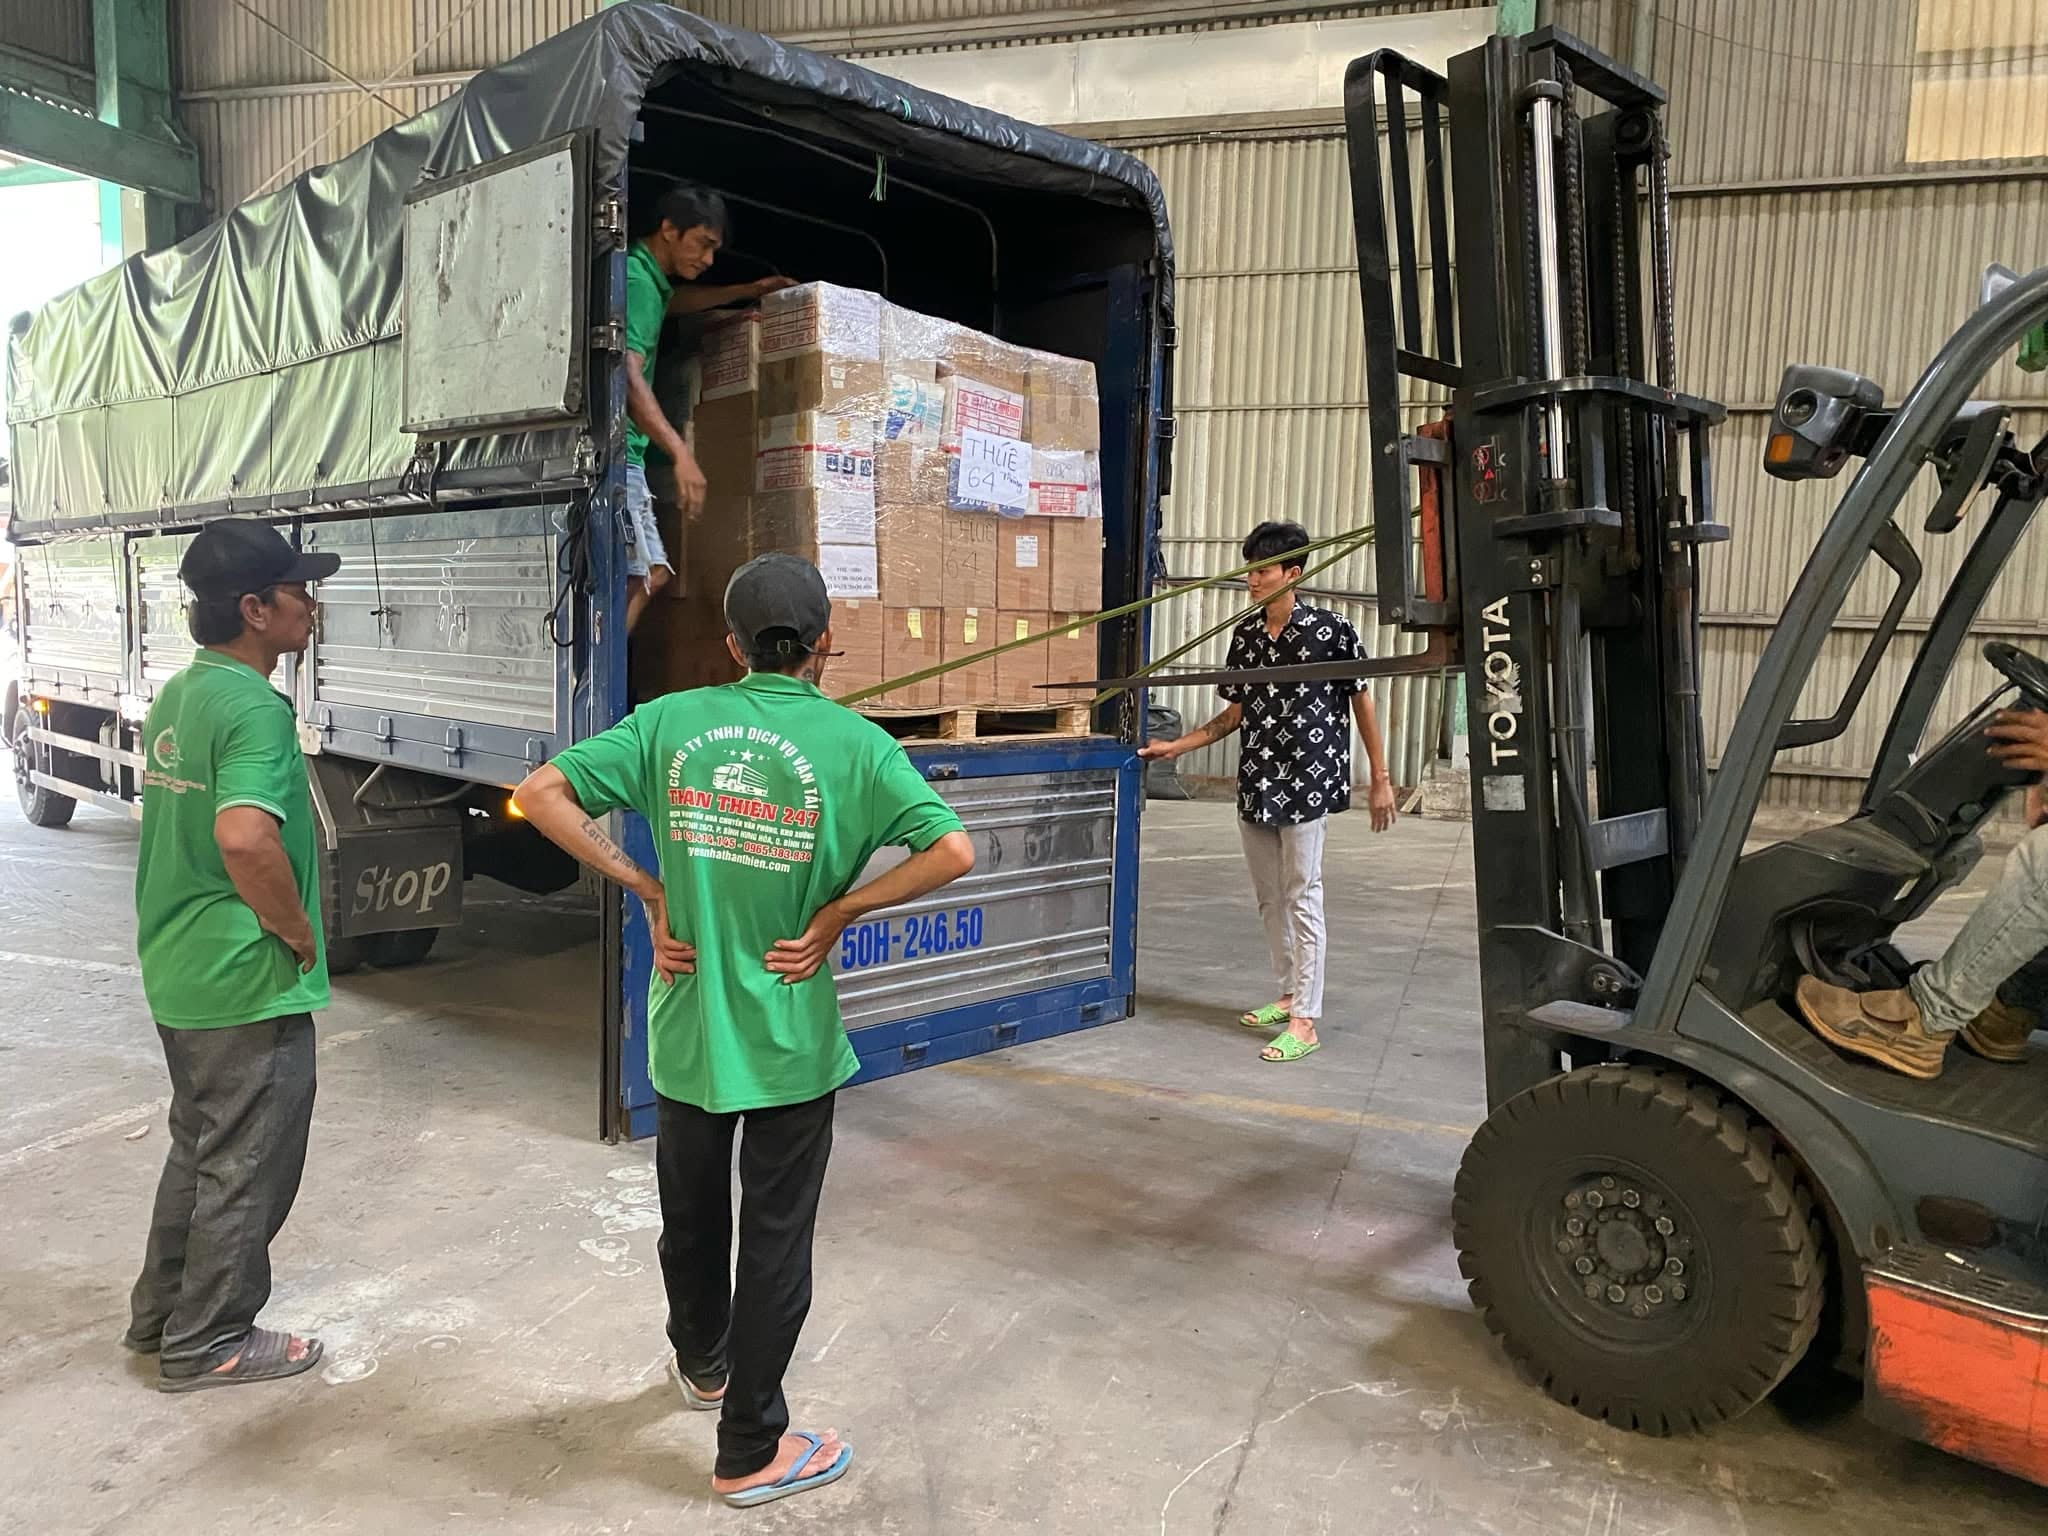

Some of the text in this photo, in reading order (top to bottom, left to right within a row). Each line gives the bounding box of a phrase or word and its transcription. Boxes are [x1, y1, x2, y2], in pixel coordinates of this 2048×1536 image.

[968, 465, 995, 493] 64
[946, 548, 980, 578] 64
[1481, 596, 1518, 767] TOYOTA
[668, 749, 689, 787] CÔNG
[684, 735, 703, 752] TY
[704, 725, 744, 743] TNHH
[747, 726, 781, 747] DỊCH
[779, 739, 799, 759] VỤ
[792, 755, 816, 785] VẬN
[717, 794, 779, 821] THIỆN
[781, 806, 820, 827] 247
[352, 862, 451, 917] Stop
[841, 907, 983, 970] 50H-246.50
